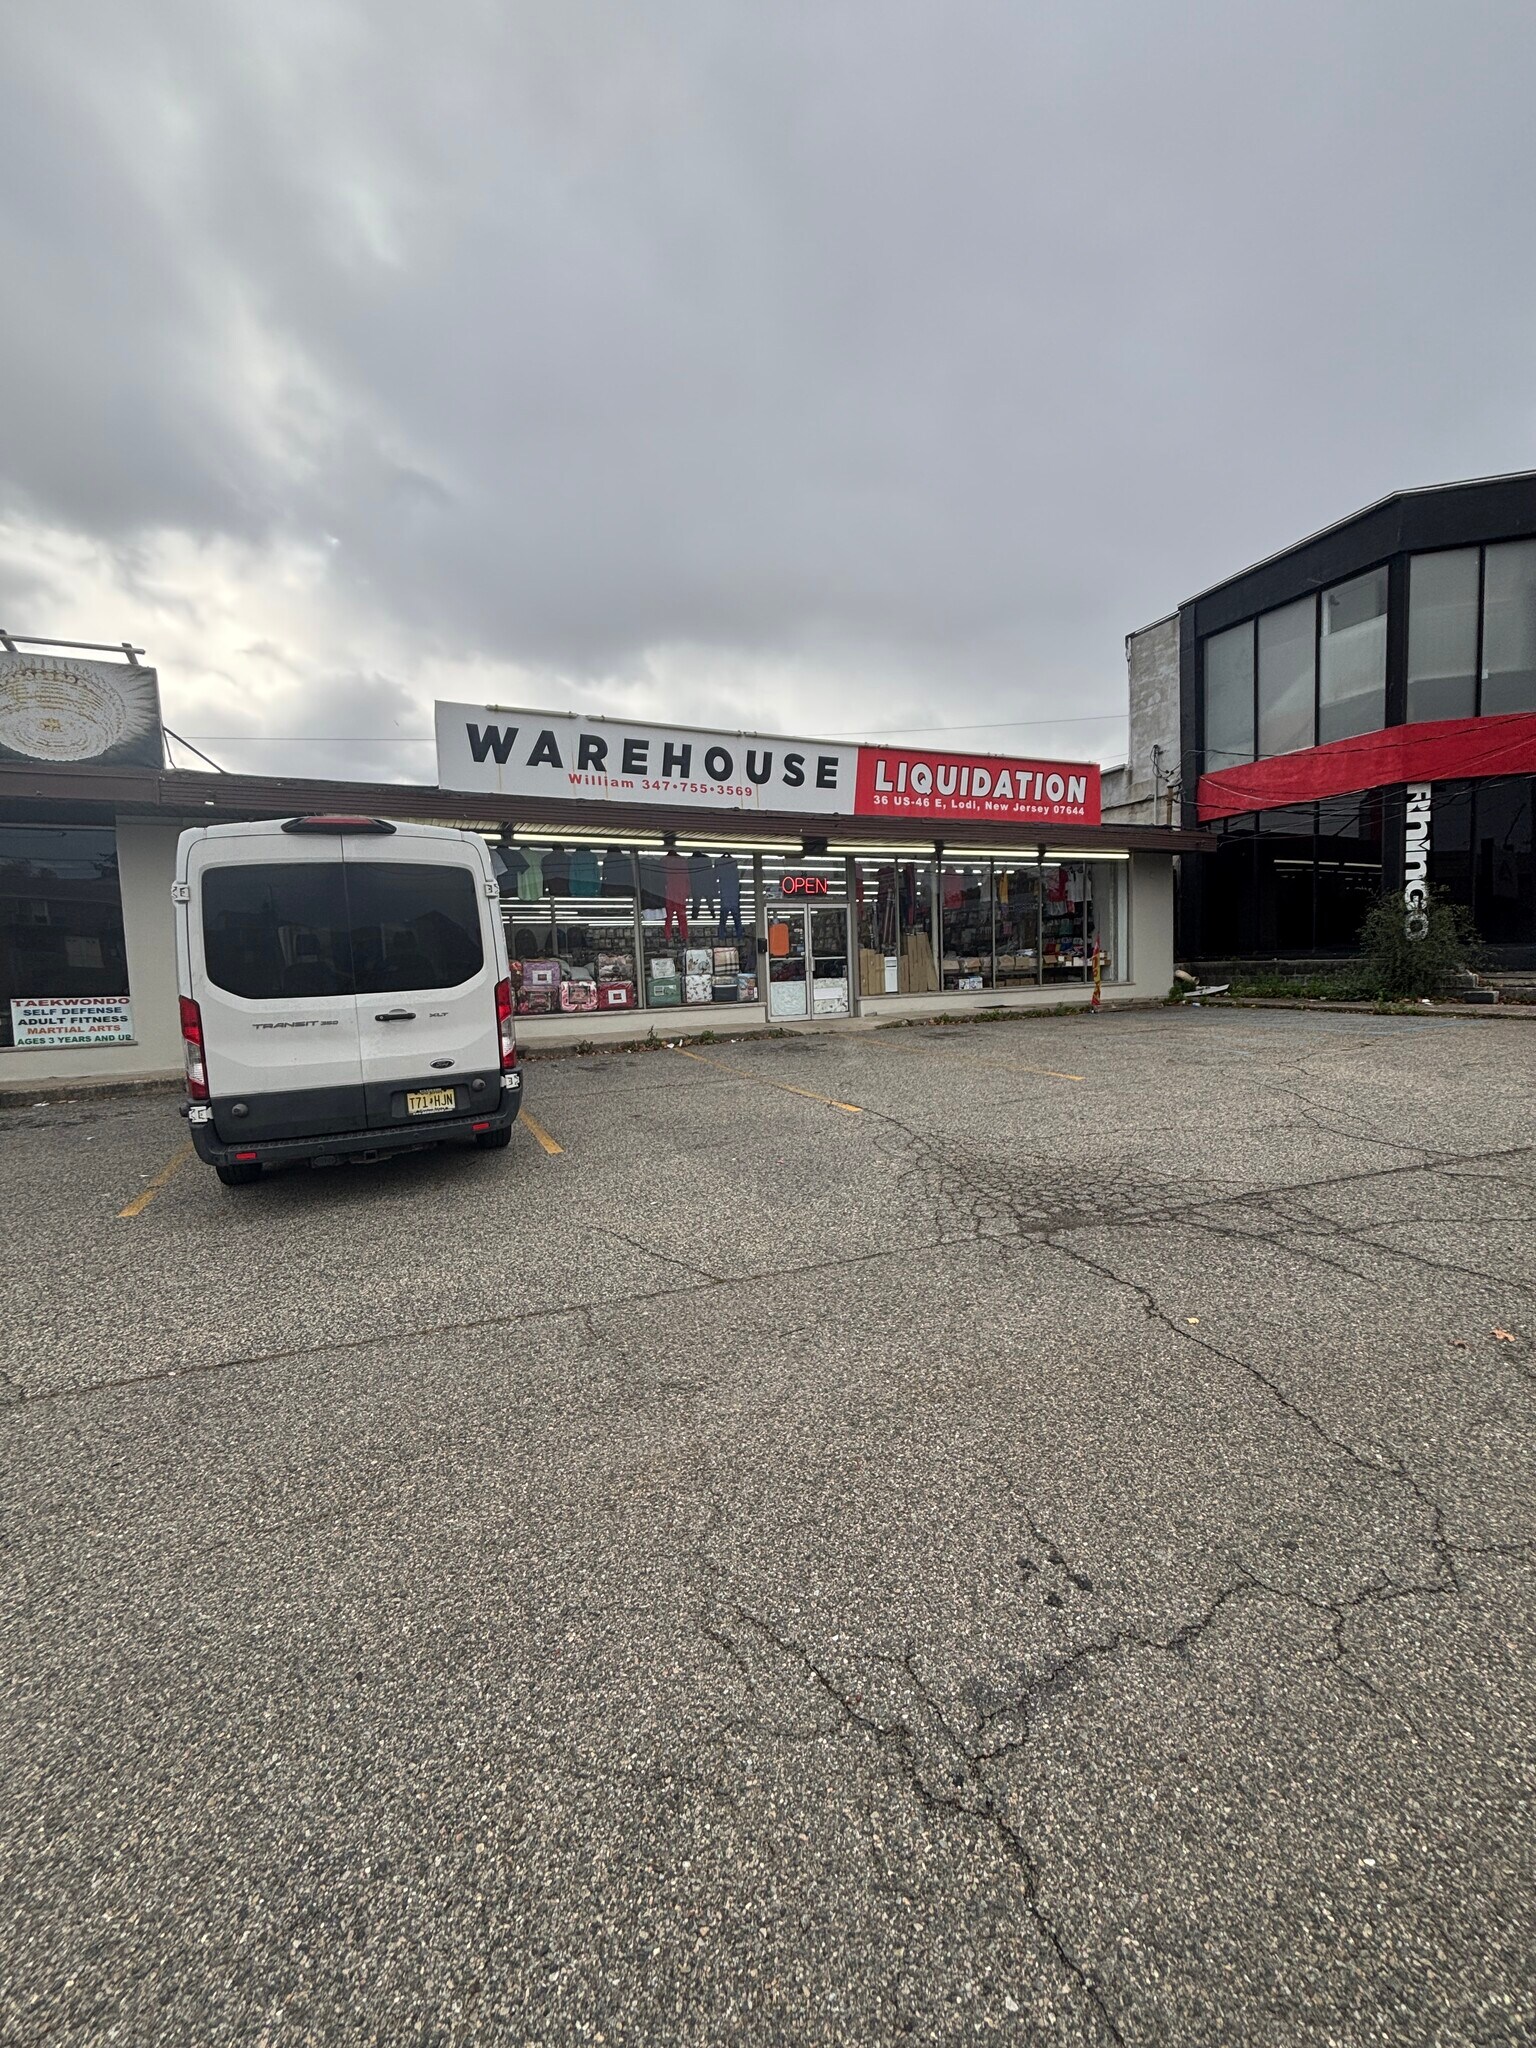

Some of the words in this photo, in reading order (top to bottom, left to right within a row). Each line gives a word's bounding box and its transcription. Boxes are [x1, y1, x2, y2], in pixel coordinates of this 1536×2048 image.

[466, 723, 839, 789] WAREHOUSE
[568, 773, 634, 789] William
[875, 760, 1087, 804] LIQUIDATION
[873, 795, 889, 805] 36
[893, 796, 930, 808] US-46
[935, 799, 947, 810] E,
[951, 799, 981, 812] Lodi,
[984, 801, 1009, 811] New
[1013, 803, 1050, 815] Jersey
[1053, 805, 1085, 816] 07644
[782, 876, 827, 894] OPEN
[12, 998, 130, 1007] TAEKWONDO
[23, 1008, 57, 1016] SELF
[61, 1006, 122, 1015] DEFENSE
[18, 1017, 66, 1026] ADULT
[70, 1015, 129, 1024] FITNESS
[252, 1020, 320, 1030] TRANSIT
[27, 1026, 85, 1035] MARTIAL
[88, 1024, 121, 1032] ARTS
[17, 1037, 46, 1045] AGES
[57, 1035, 92, 1044] YEARS
[94, 1034, 115, 1042] AND
